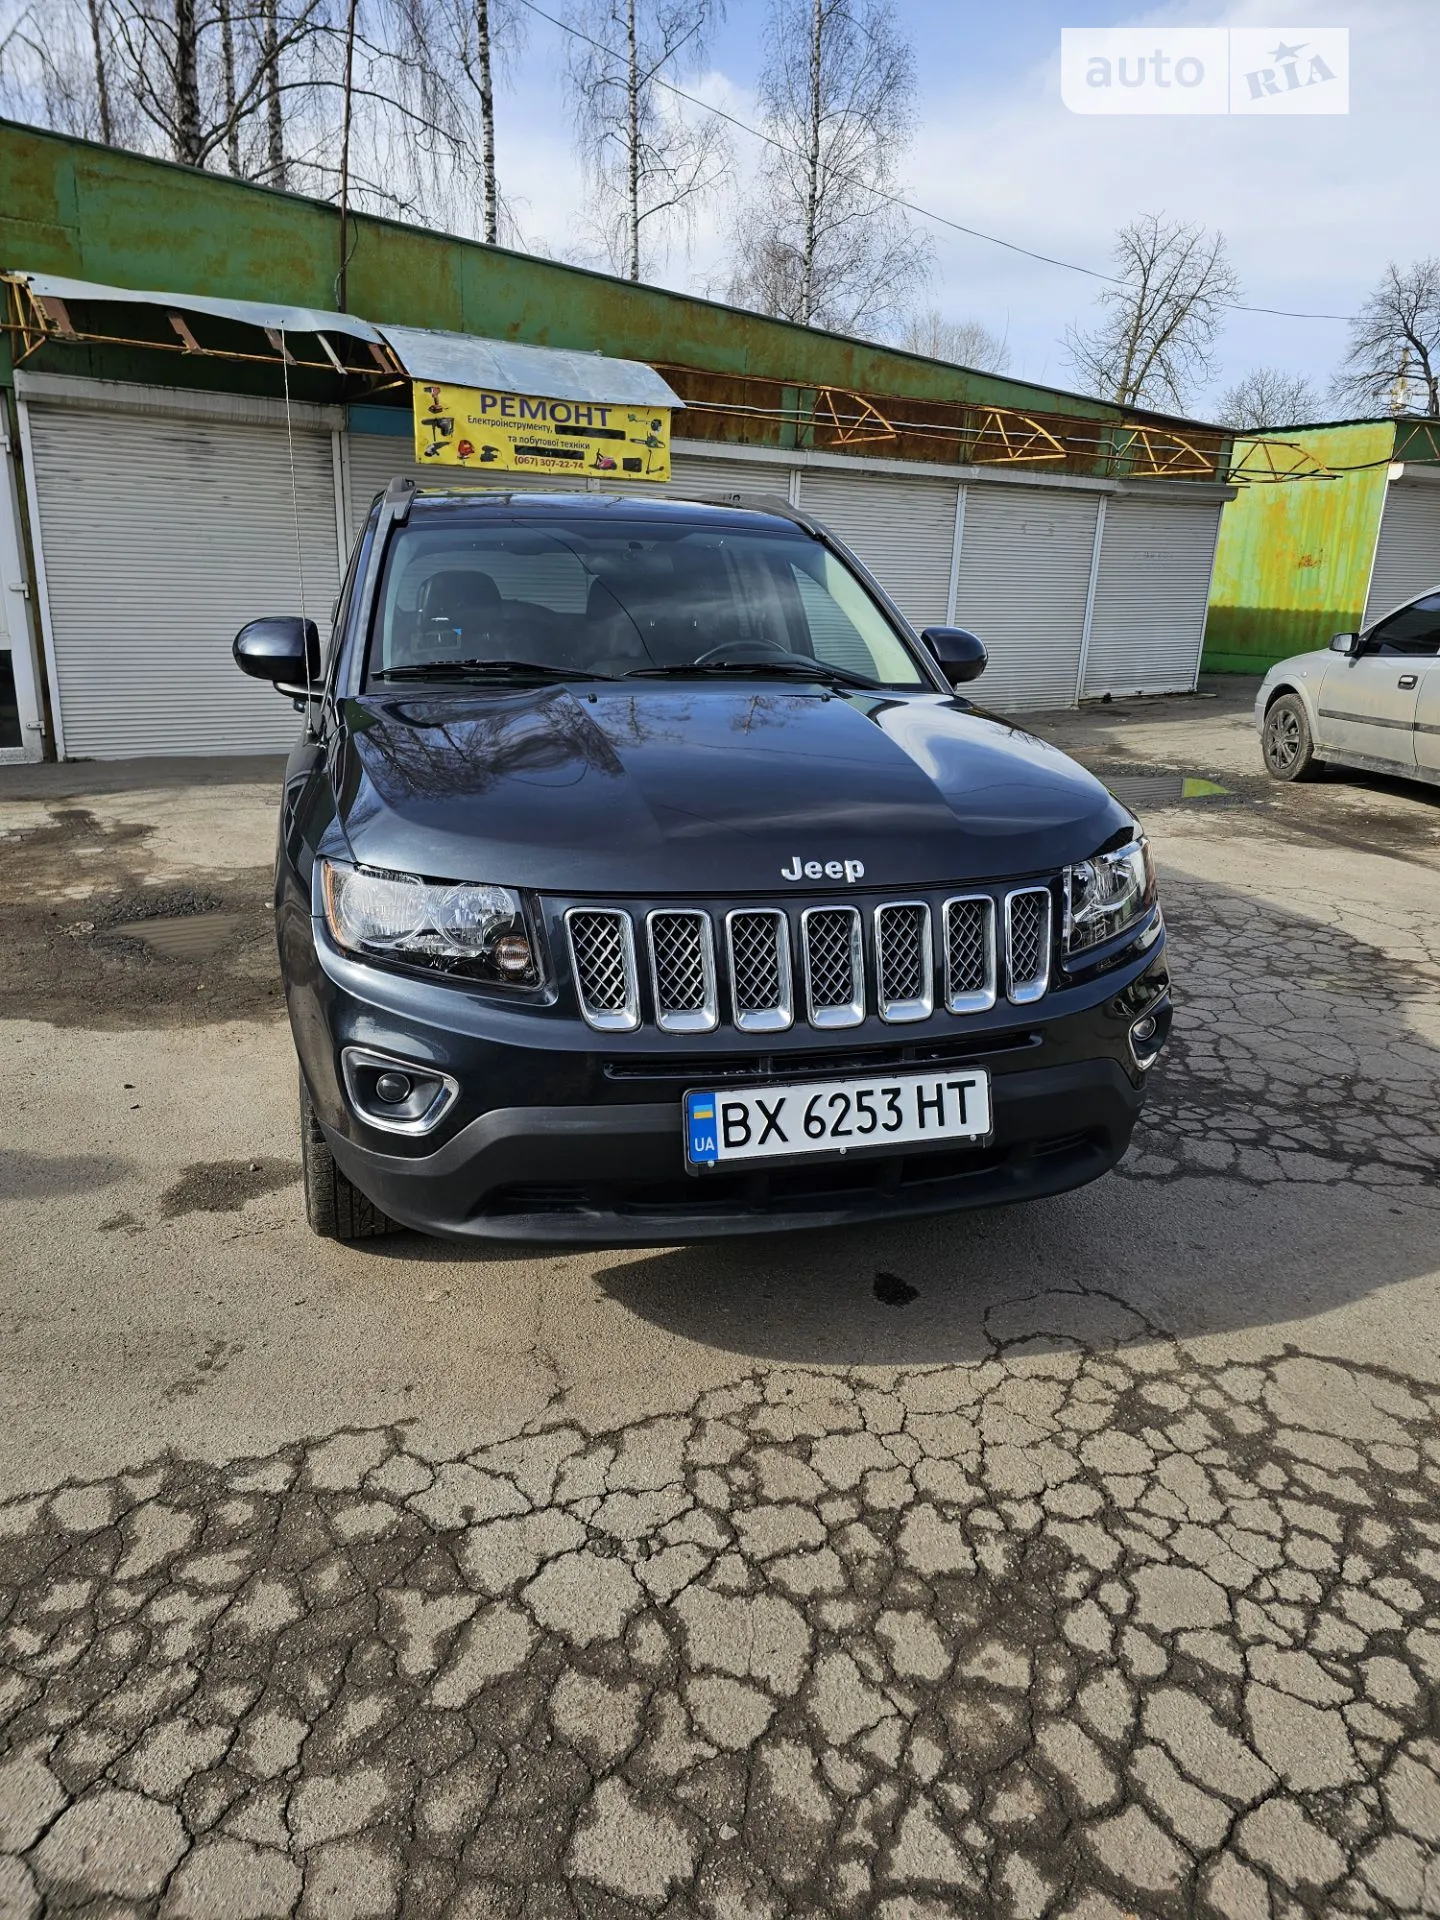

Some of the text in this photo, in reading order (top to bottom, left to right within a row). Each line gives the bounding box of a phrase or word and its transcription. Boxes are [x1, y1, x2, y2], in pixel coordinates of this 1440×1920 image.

[481, 394, 612, 427] РЕМОНТ
[467, 415, 553, 433] Електроінструменту,
[508, 435, 590, 450] та побутової техніки
[514, 455, 584, 469] (067) 307-22-74
[781, 856, 865, 883] Jeep
[803, 1087, 903, 1139] 6253
[695, 1136, 714, 1151] UA
